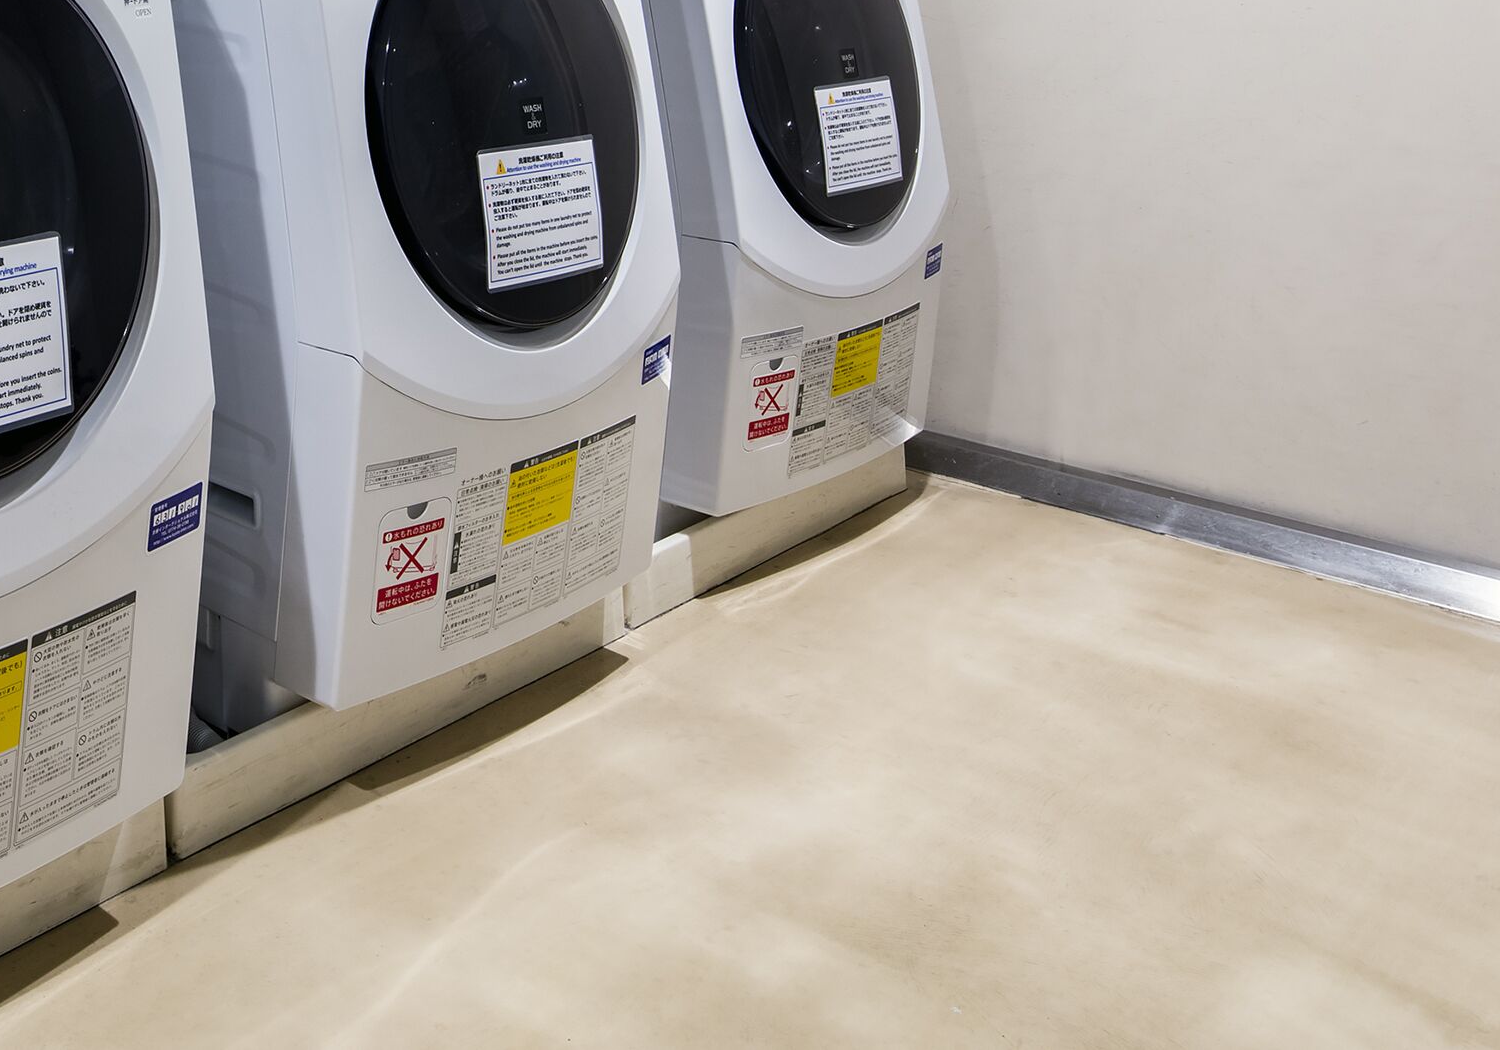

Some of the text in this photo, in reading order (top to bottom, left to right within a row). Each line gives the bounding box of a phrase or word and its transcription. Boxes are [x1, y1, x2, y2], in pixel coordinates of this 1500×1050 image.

[523, 104, 542, 113] WASH
[527, 121, 541, 129] DRY
[14, 262, 37, 273] machine
[33, 335, 51, 346] protect
